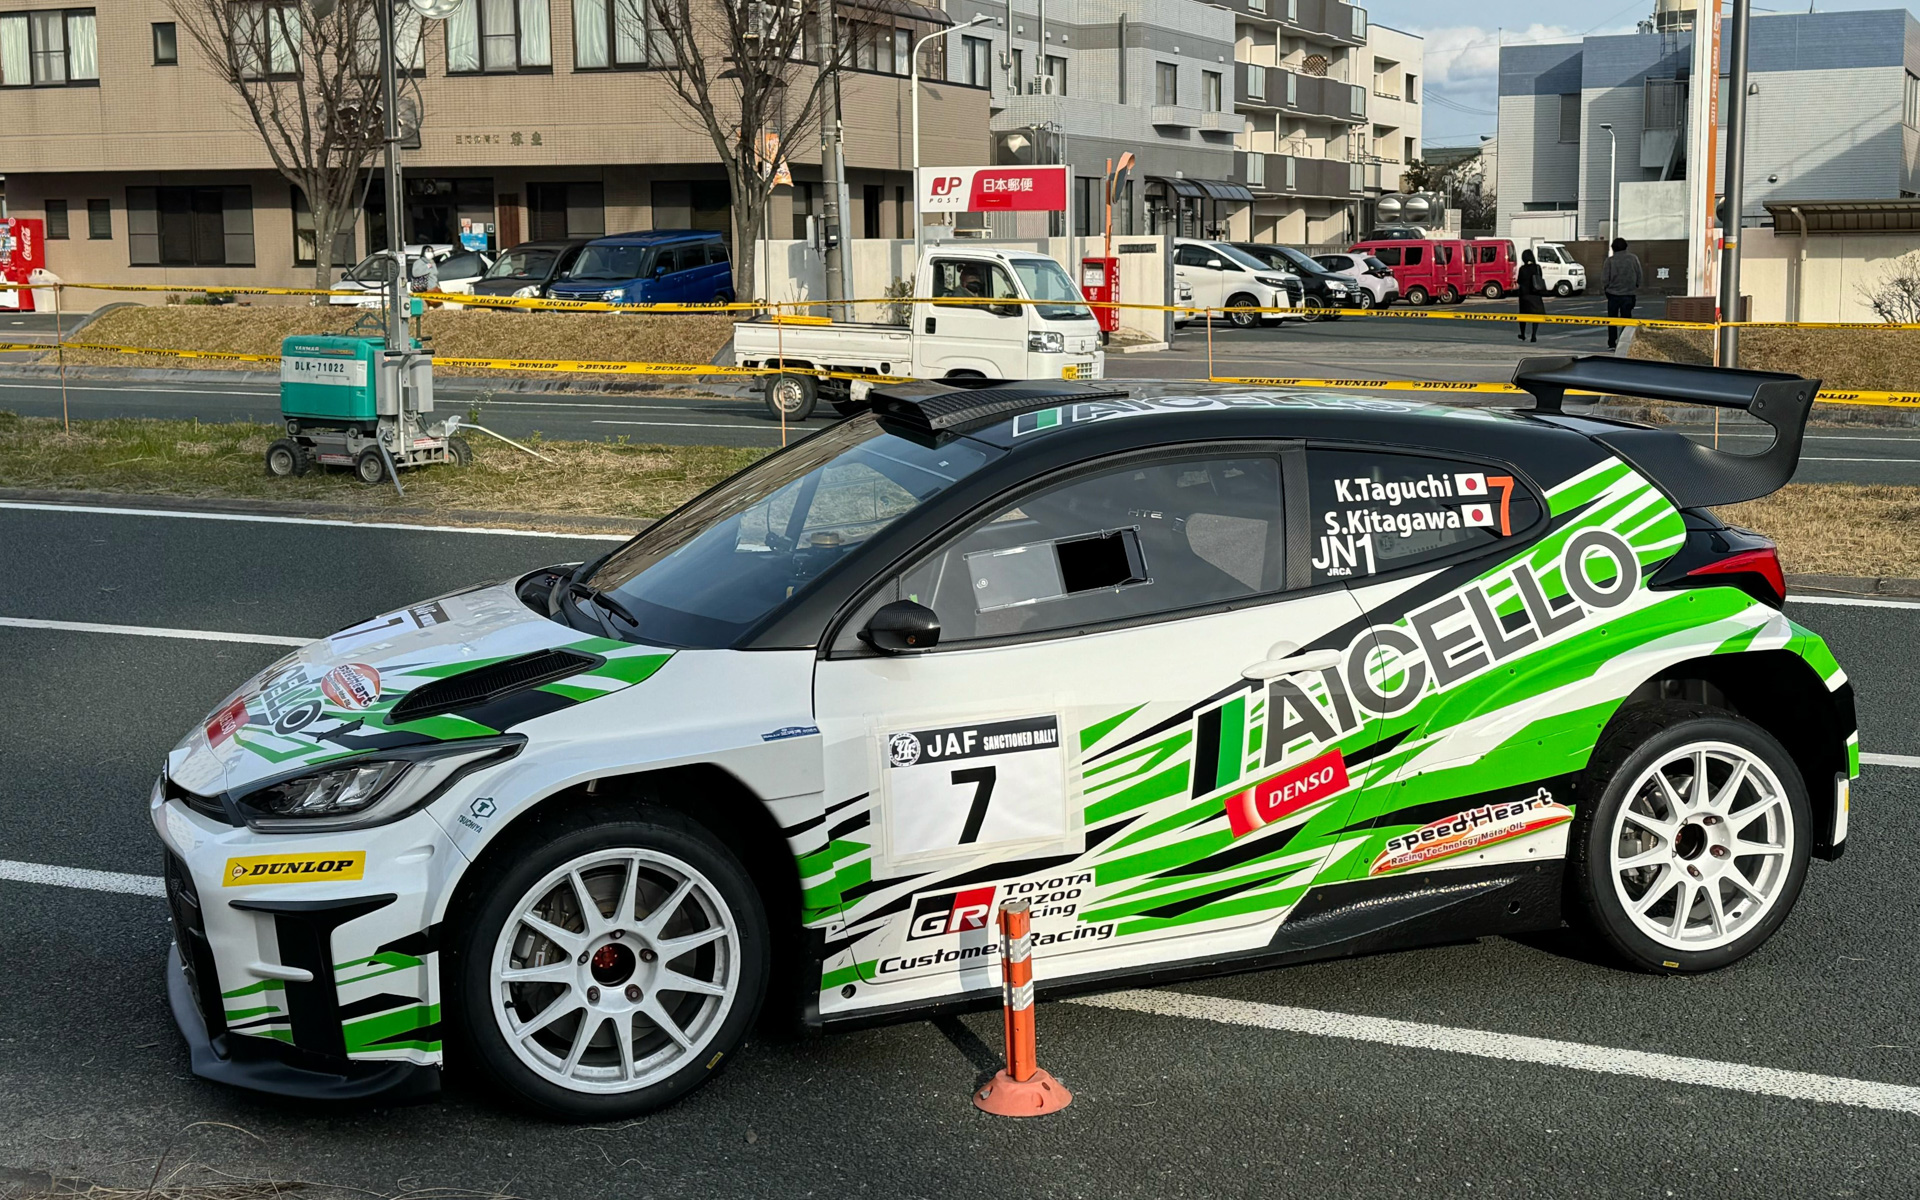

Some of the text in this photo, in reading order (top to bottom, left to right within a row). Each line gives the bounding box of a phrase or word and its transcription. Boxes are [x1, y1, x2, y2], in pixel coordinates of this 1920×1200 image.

[983, 177, 1033, 193] 日本郵便
[294, 361, 345, 373] DLK-71022
[1334, 474, 1453, 507] K.Taguchi
[1486, 476, 1515, 537] 7
[1324, 509, 1461, 538] S.Kitagawa
[1311, 533, 1377, 574] JN1
[1327, 567, 1352, 577] JRCA
[1263, 531, 1638, 769] AICELLO
[926, 730, 978, 758] JAF
[983, 731, 1033, 751] SANCTIONED
[1033, 728, 1057, 745] RALLY
[1268, 766, 1334, 808] DENSO
[950, 765, 997, 845] 7
[1387, 788, 1551, 851] speedHeart
[456, 814, 483, 834] TSUCHIYA
[1390, 821, 1526, 866] Racing Technology Motor OIL
[249, 859, 354, 876] DUNLOP
[1003, 873, 1092, 896] TOYOTA
[910, 903, 990, 939] GR
[1029, 903, 1076, 923] cing
[879, 943, 1001, 974] Custome
